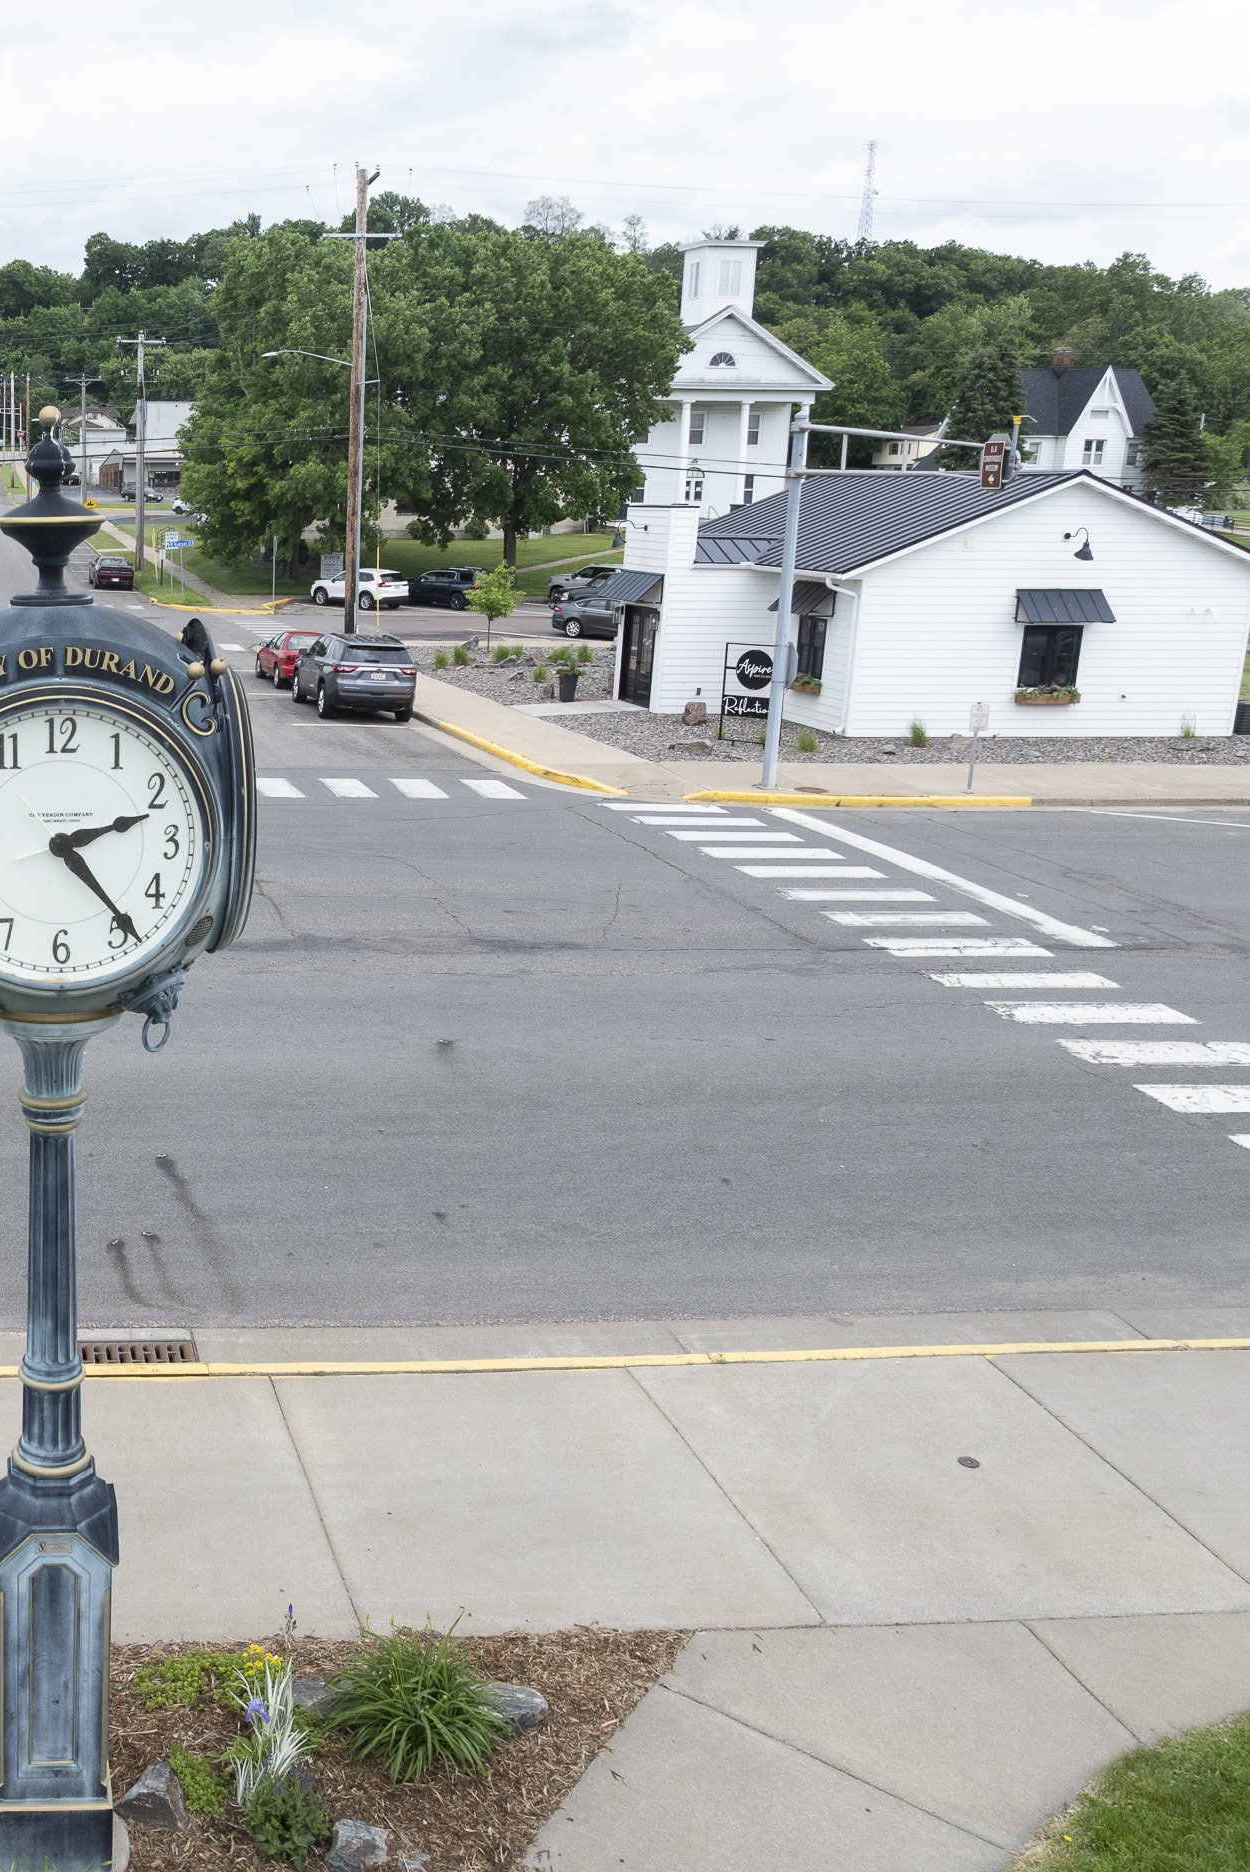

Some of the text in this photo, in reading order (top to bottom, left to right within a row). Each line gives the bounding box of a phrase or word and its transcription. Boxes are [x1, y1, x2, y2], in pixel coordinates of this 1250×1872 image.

[18, 647, 54, 670] OF
[65, 646, 175, 694] DURAND
[736, 658, 773, 678] Aspire
[722, 696, 770, 715] Reflectio
[45, 717, 80, 753] 12
[110, 733, 124, 770] 1
[148, 773, 168, 809] 2
[164, 825, 179, 860] 3
[145, 873, 165, 909] 4
[52, 930, 70, 964] 6
[108, 916, 129, 949] 5
